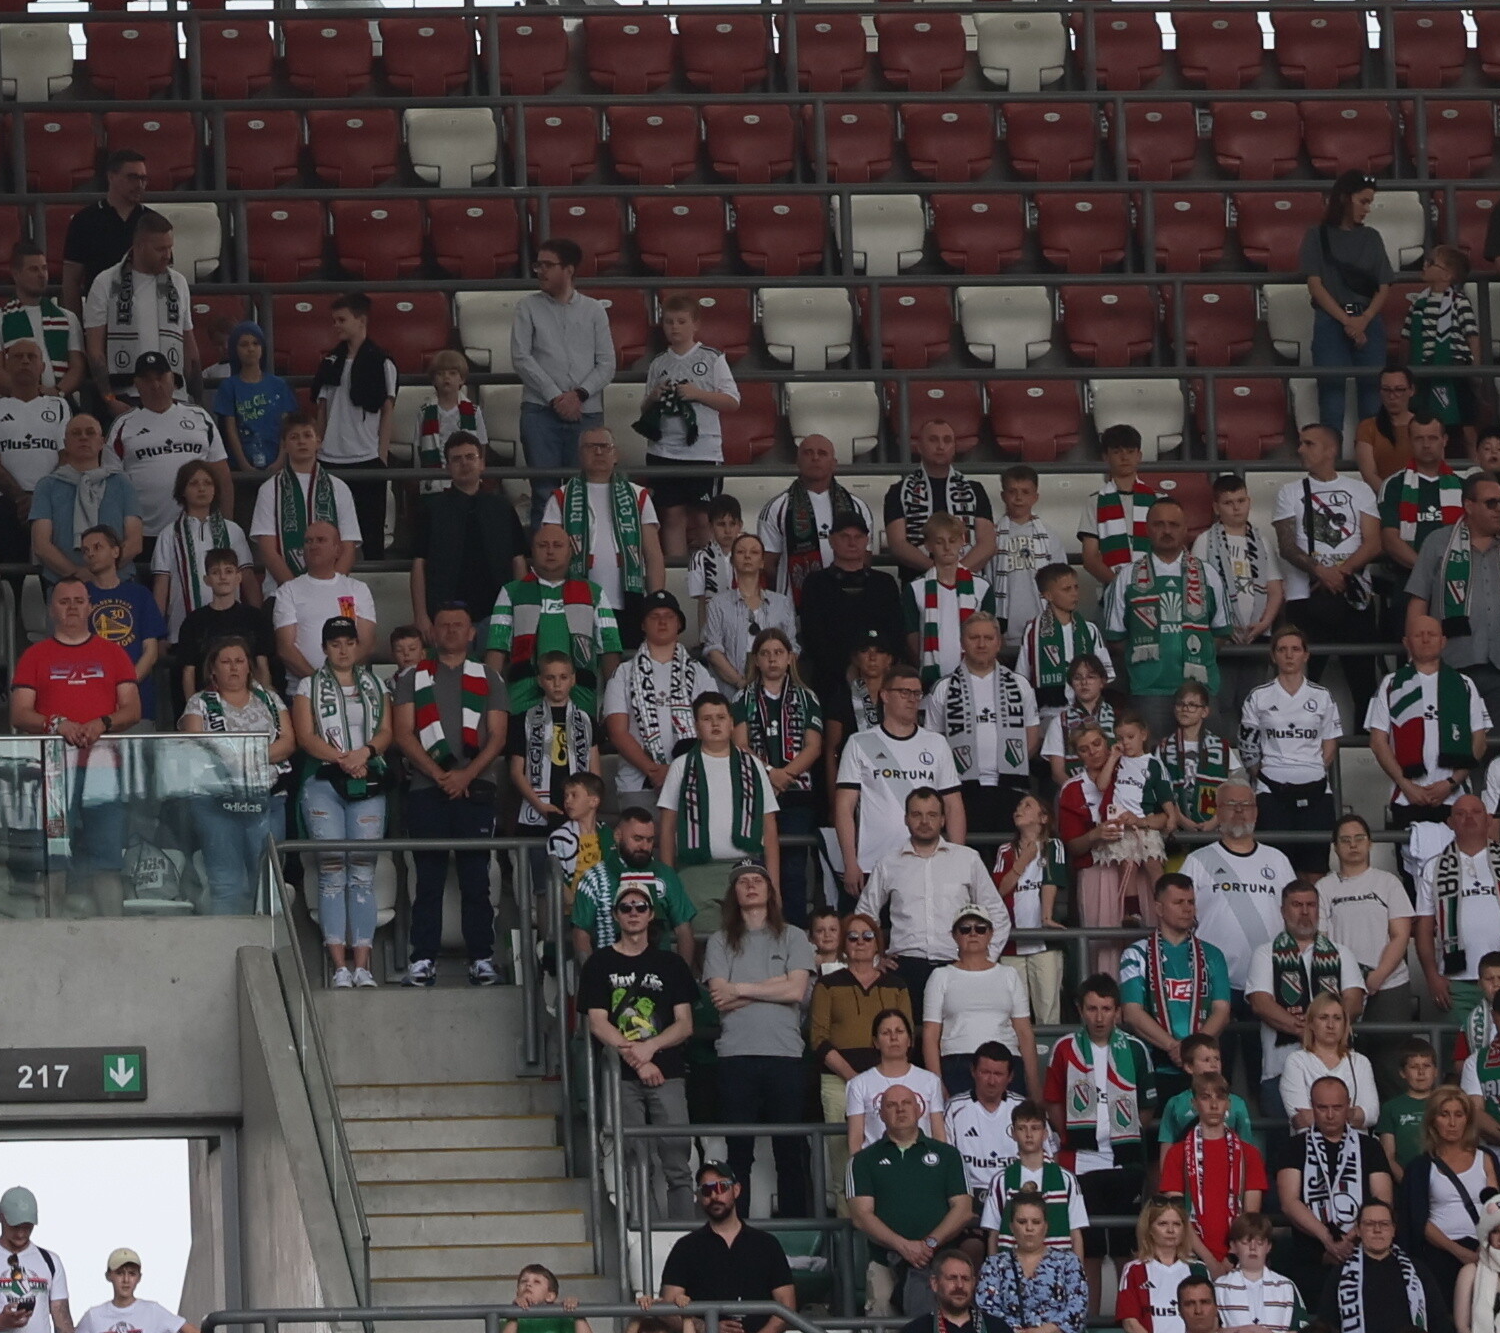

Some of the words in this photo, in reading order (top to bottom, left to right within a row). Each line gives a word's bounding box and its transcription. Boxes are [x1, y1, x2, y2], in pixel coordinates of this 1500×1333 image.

[0, 434, 58, 451] Plus500
[136, 437, 203, 461] Plus500
[110, 610, 124, 620] 30
[1266, 728, 1318, 740] Plus500
[873, 768, 934, 781] FORTUNA
[222, 802, 262, 813] adidas
[1212, 882, 1276, 894] FORTUNA
[1331, 891, 1389, 909] METALLICA
[17, 1064, 70, 1089] 217
[1342, 1266, 1360, 1332] LEGIA
